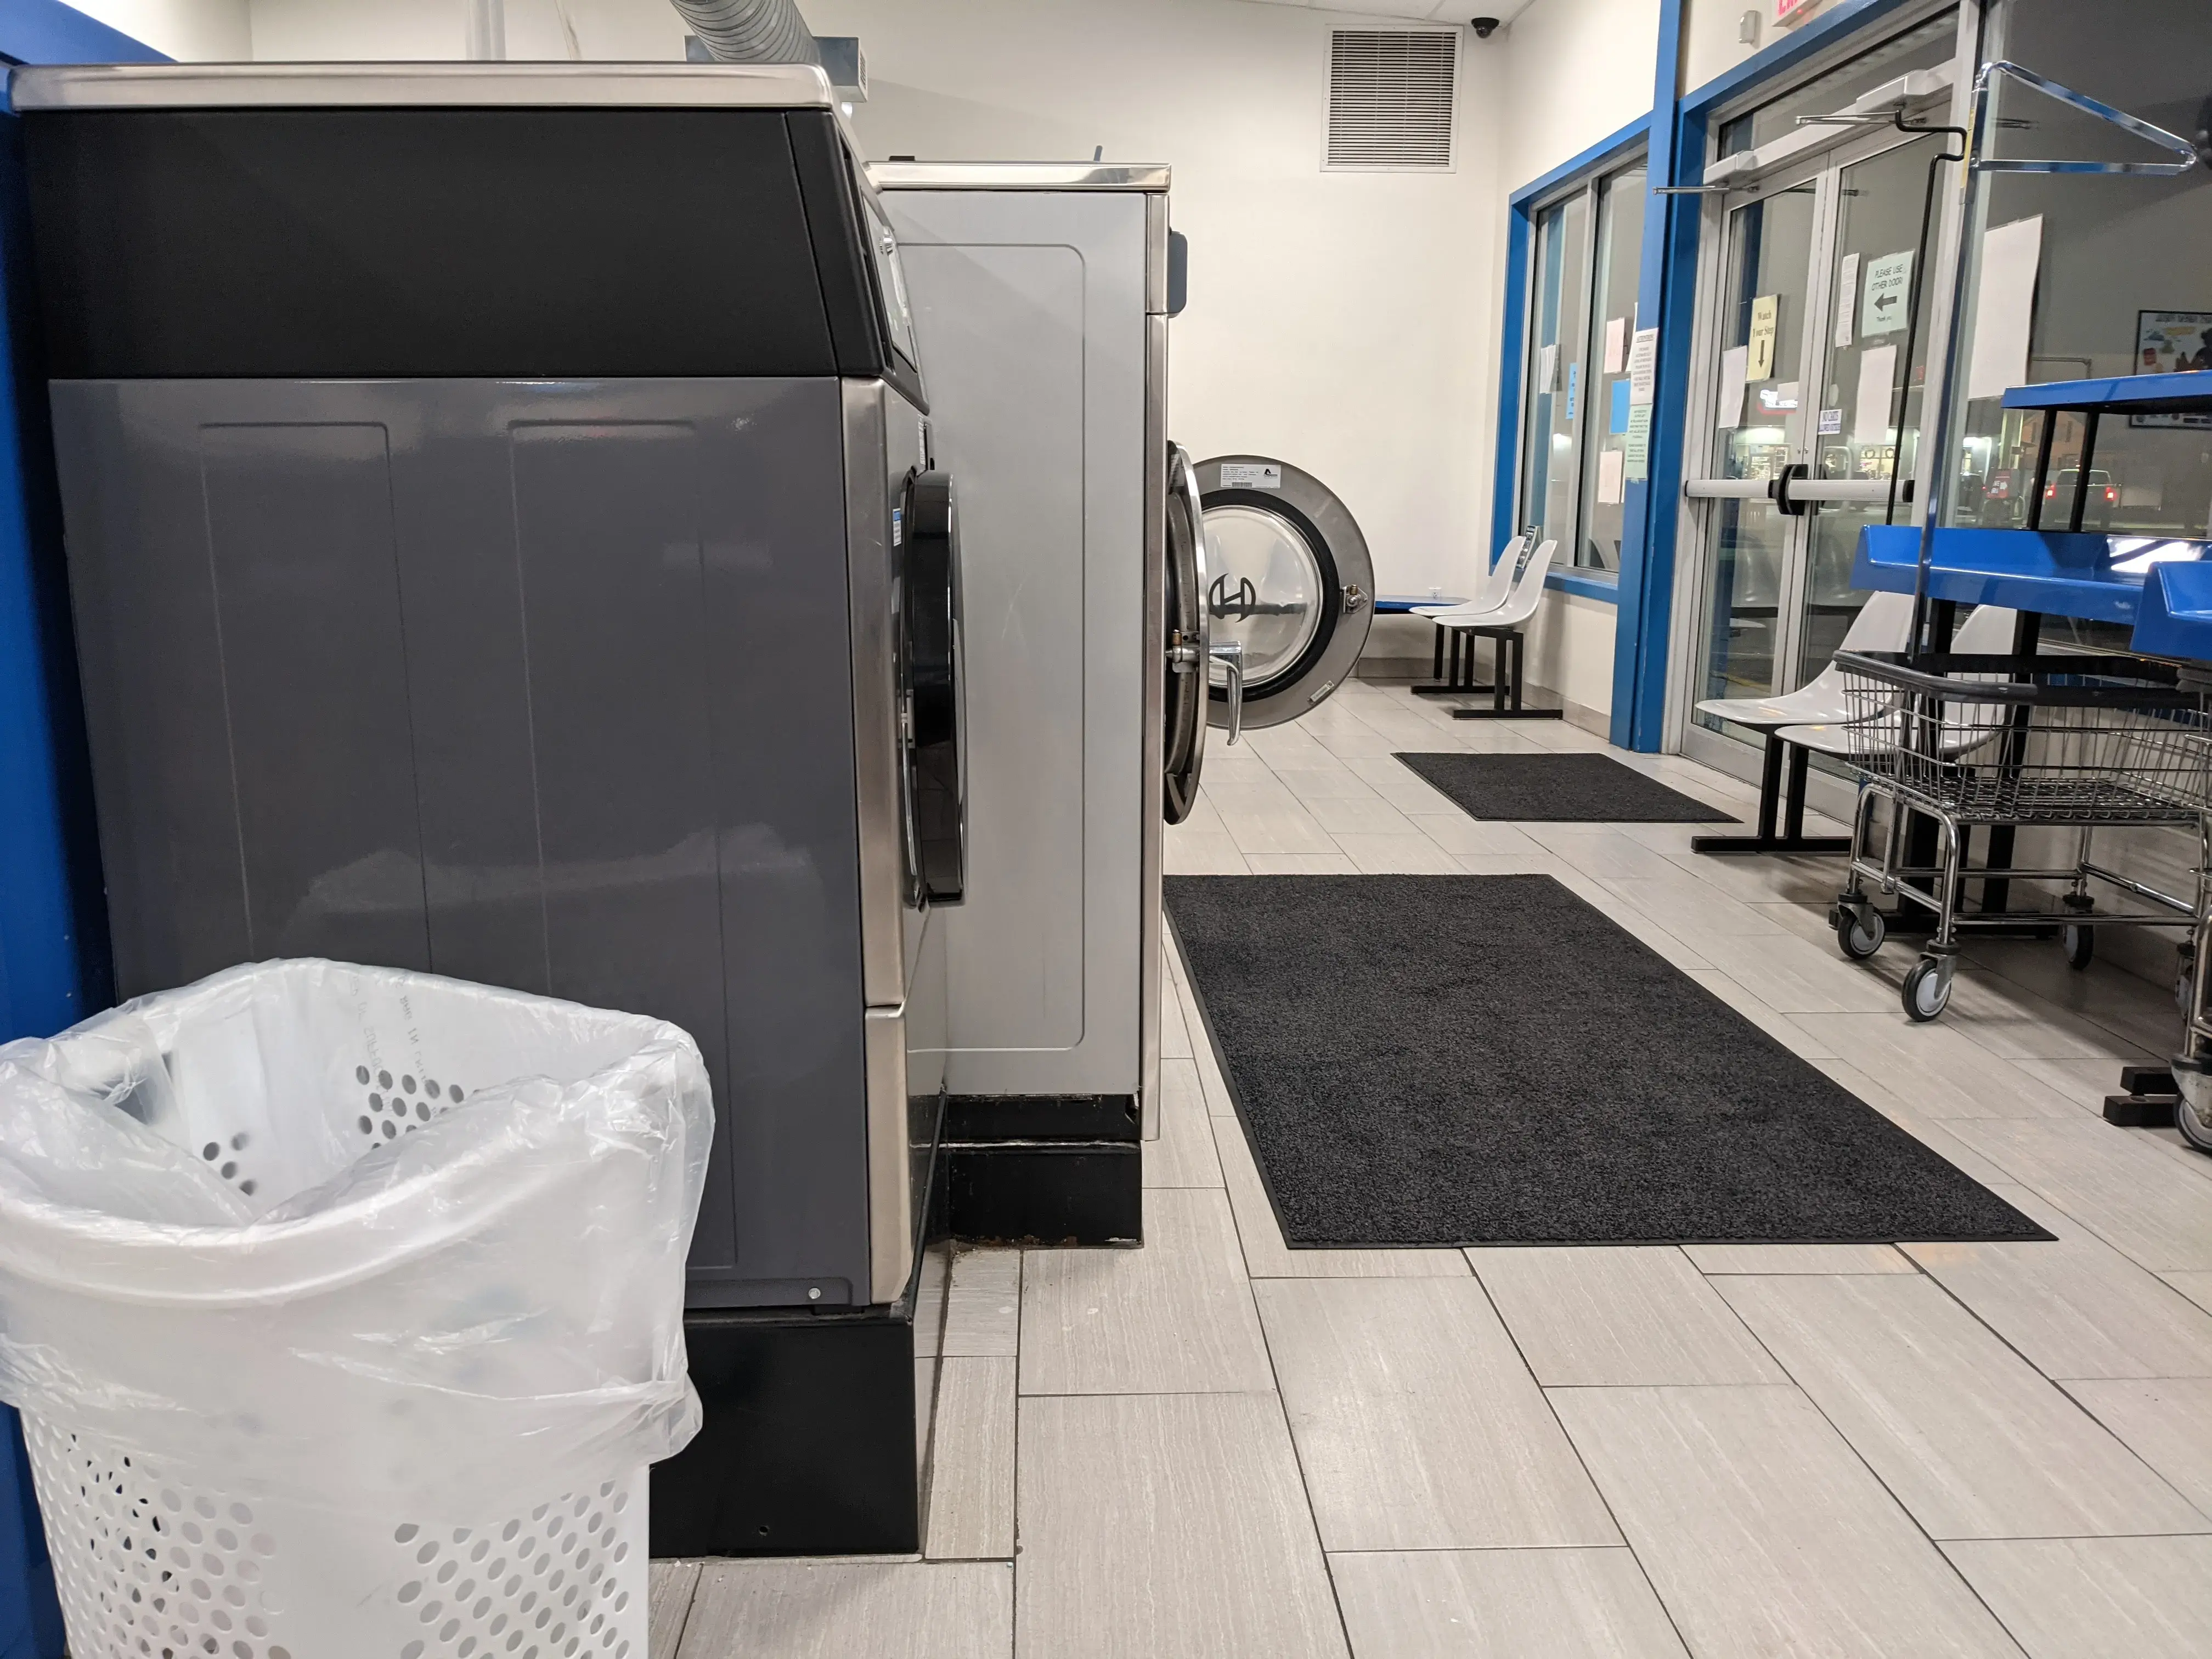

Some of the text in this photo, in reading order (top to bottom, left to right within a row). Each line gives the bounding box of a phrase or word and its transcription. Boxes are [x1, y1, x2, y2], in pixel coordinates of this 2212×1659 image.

[1875, 264, 1904, 279] PLEASE USE
[1871, 280, 1888, 291] OTHER
